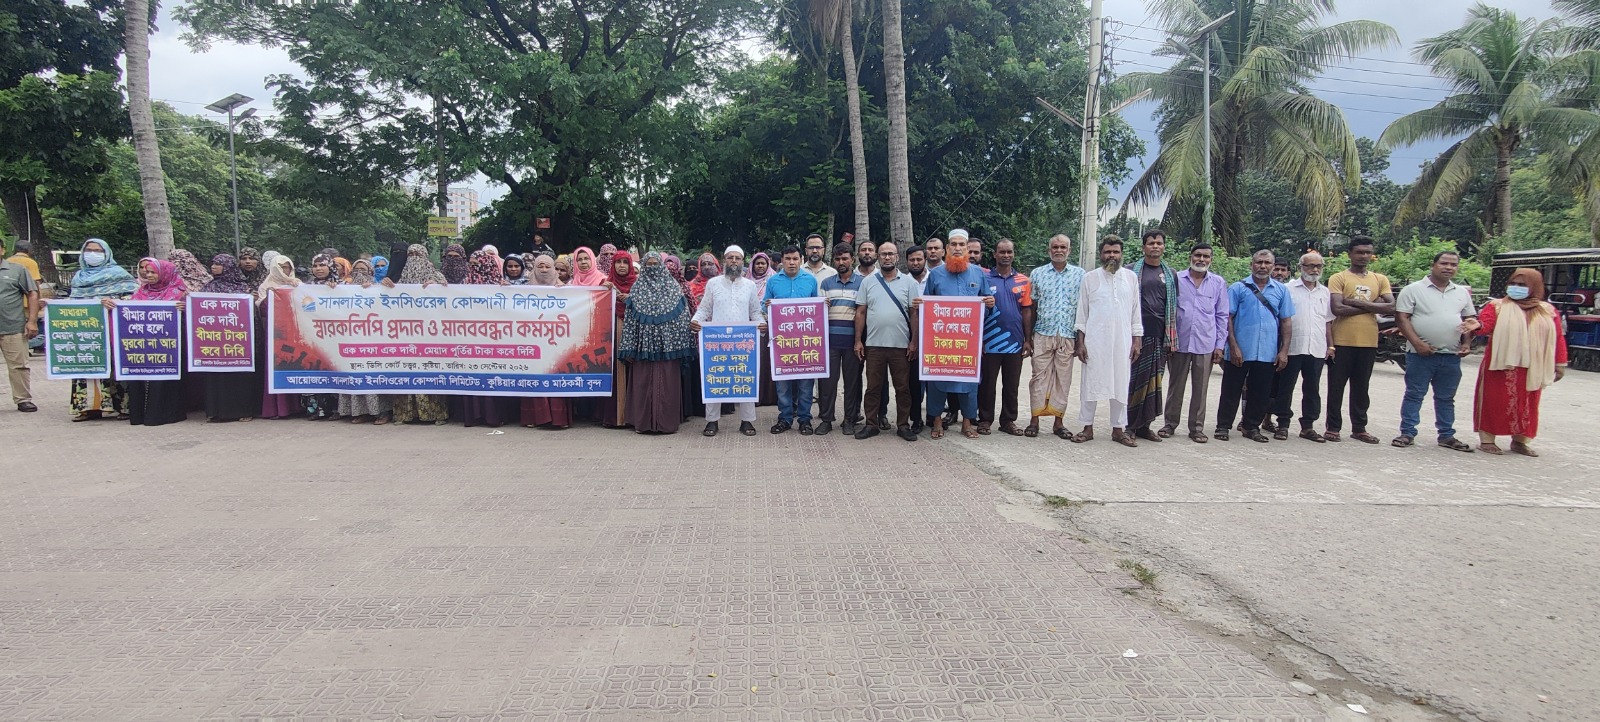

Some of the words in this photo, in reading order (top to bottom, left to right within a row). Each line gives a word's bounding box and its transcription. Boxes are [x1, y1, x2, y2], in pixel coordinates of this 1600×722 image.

[200, 300, 218, 310] এক
[220, 300, 240, 311] দফা
[318, 294, 376, 310] সানলাইফ
[379, 292, 447, 309] ইনসিওরেন্স
[452, 294, 508, 310] কোম্পানী
[513, 294, 568, 310] লিমিটেড
[122, 307, 145, 321] বীমার
[148, 311, 173, 321] মেয়াদ
[780, 306, 796, 316] এক
[798, 305, 816, 315] দফা
[933, 303, 951, 318] বীমার
[952, 307, 972, 318] মেয়াদ
[51, 320, 79, 330] মানুষের
[198, 316, 215, 325] এক
[128, 323, 144, 334] শেষ
[387, 319, 424, 339] প্রদান
[428, 320, 438, 336] ও
[442, 320, 513, 340] মানববন্ধন
[517, 313, 571, 346] কর্মসূচী
[778, 322, 794, 332] এক
[932, 320, 944, 333] যদি
[946, 322, 959, 333] শেষ
[195, 327, 222, 341] বীমার
[224, 329, 248, 341] টাকা
[121, 339, 145, 351] ঘুরবো
[147, 339, 157, 349] না
[160, 339, 176, 349] আর
[776, 335, 800, 349] বীমার
[802, 335, 822, 347] টাকা
[934, 337, 953, 349] টাকার
[955, 339, 968, 350] জন্য
[200, 347, 220, 356] কবে
[223, 344, 245, 357] দিবি
[359, 347, 378, 355] দফা
[381, 347, 397, 355] এক
[424, 347, 448, 355] মেয়াদ
[474, 346, 493, 355] টাকা
[497, 348, 515, 356] কবে
[517, 346, 535, 356] দিবি
[57, 353, 75, 363] টাকা
[127, 354, 145, 364] দারে
[730, 354, 749, 362] দফা
[780, 354, 799, 364] কবে
[801, 350, 819, 363] দিবি
[924, 354, 936, 364] আর
[938, 354, 962, 365] অপেক্ষা
[384, 360, 401, 369] কোর্ট
[332, 376, 363, 386] সানলাইফ
[365, 375, 410, 386] ইনসিওরেন্স
[413, 375, 447, 387] কোম্পানী
[518, 379, 540, 388] গ্রাহক
[542, 379, 549, 388] ও
[706, 375, 731, 384] বীমার
[734, 375, 755, 383] টাকা
[732, 384, 751, 395] দিবি
